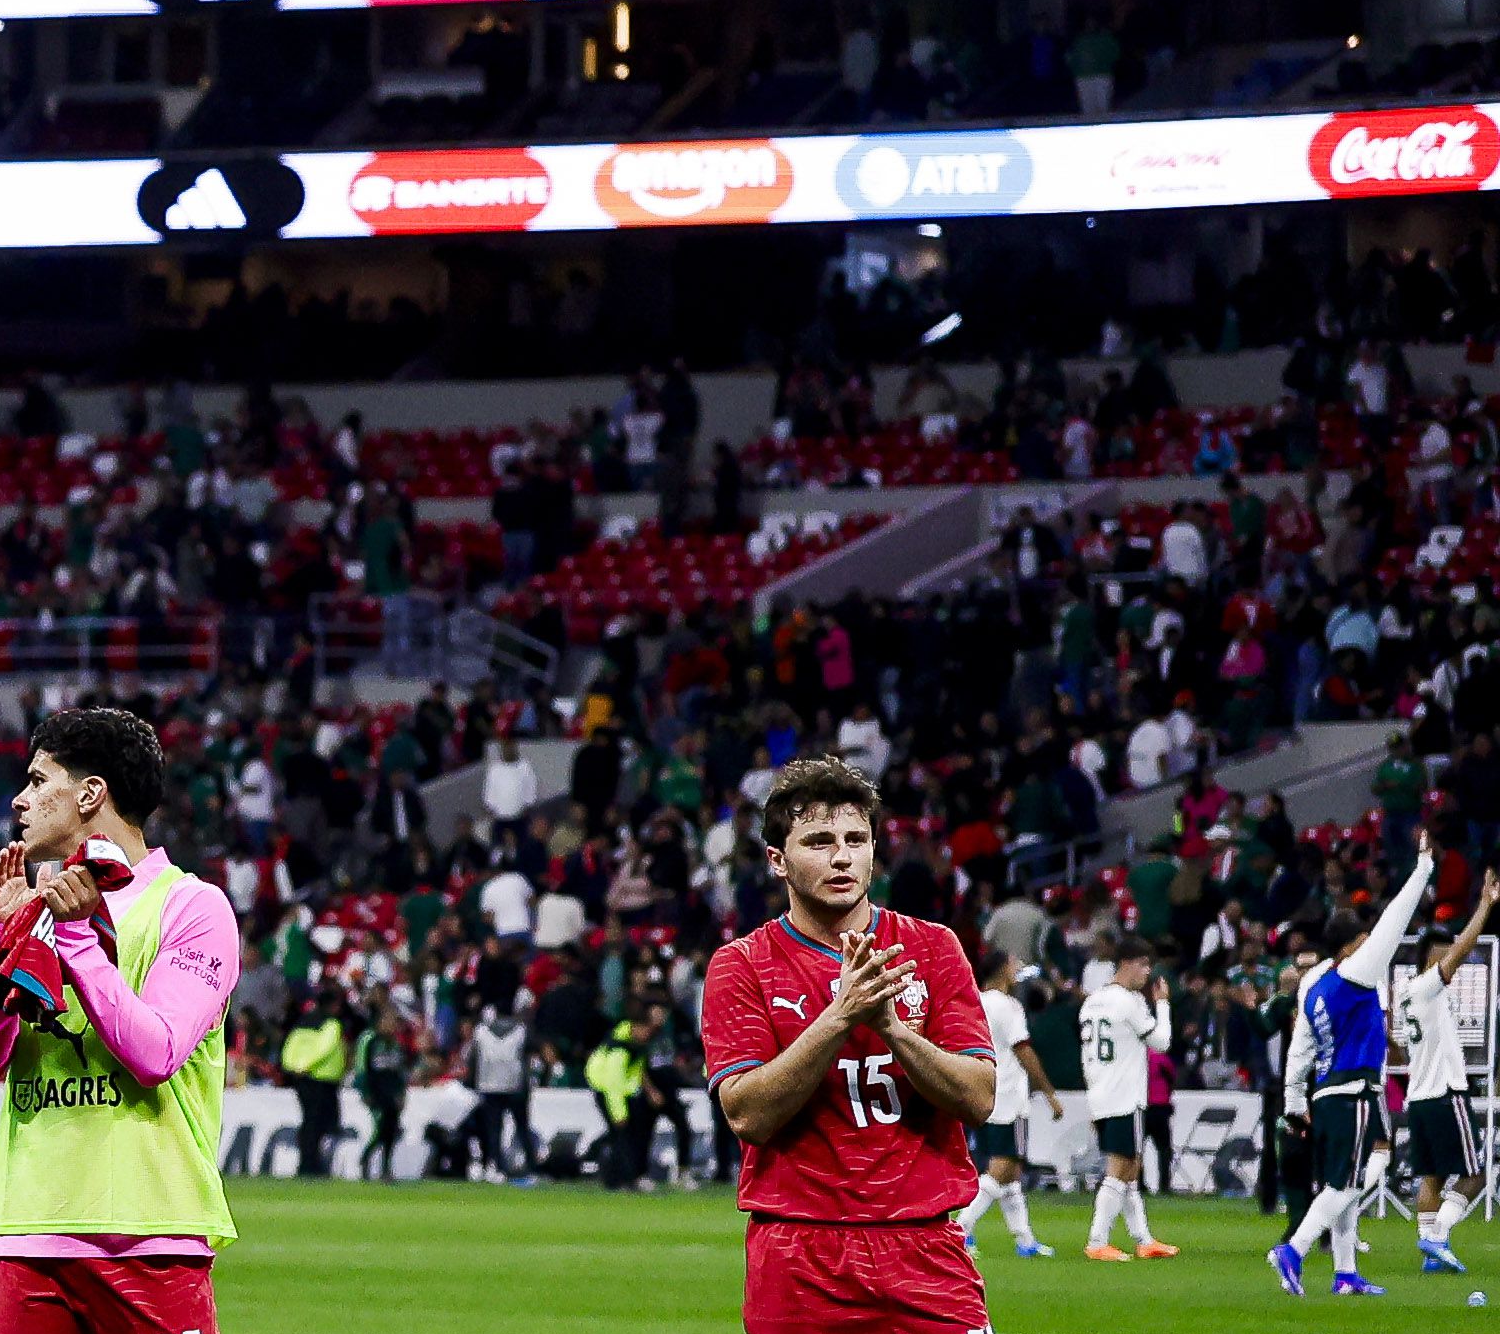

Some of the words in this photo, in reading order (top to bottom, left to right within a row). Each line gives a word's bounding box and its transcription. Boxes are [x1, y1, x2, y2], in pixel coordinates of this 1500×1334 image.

[912, 151, 1008, 197] AT&T
[169, 956, 222, 992] Portugal
[178, 947, 207, 965] visit
[33, 1070, 123, 1113] SAGRES
[837, 1053, 902, 1128] 15
